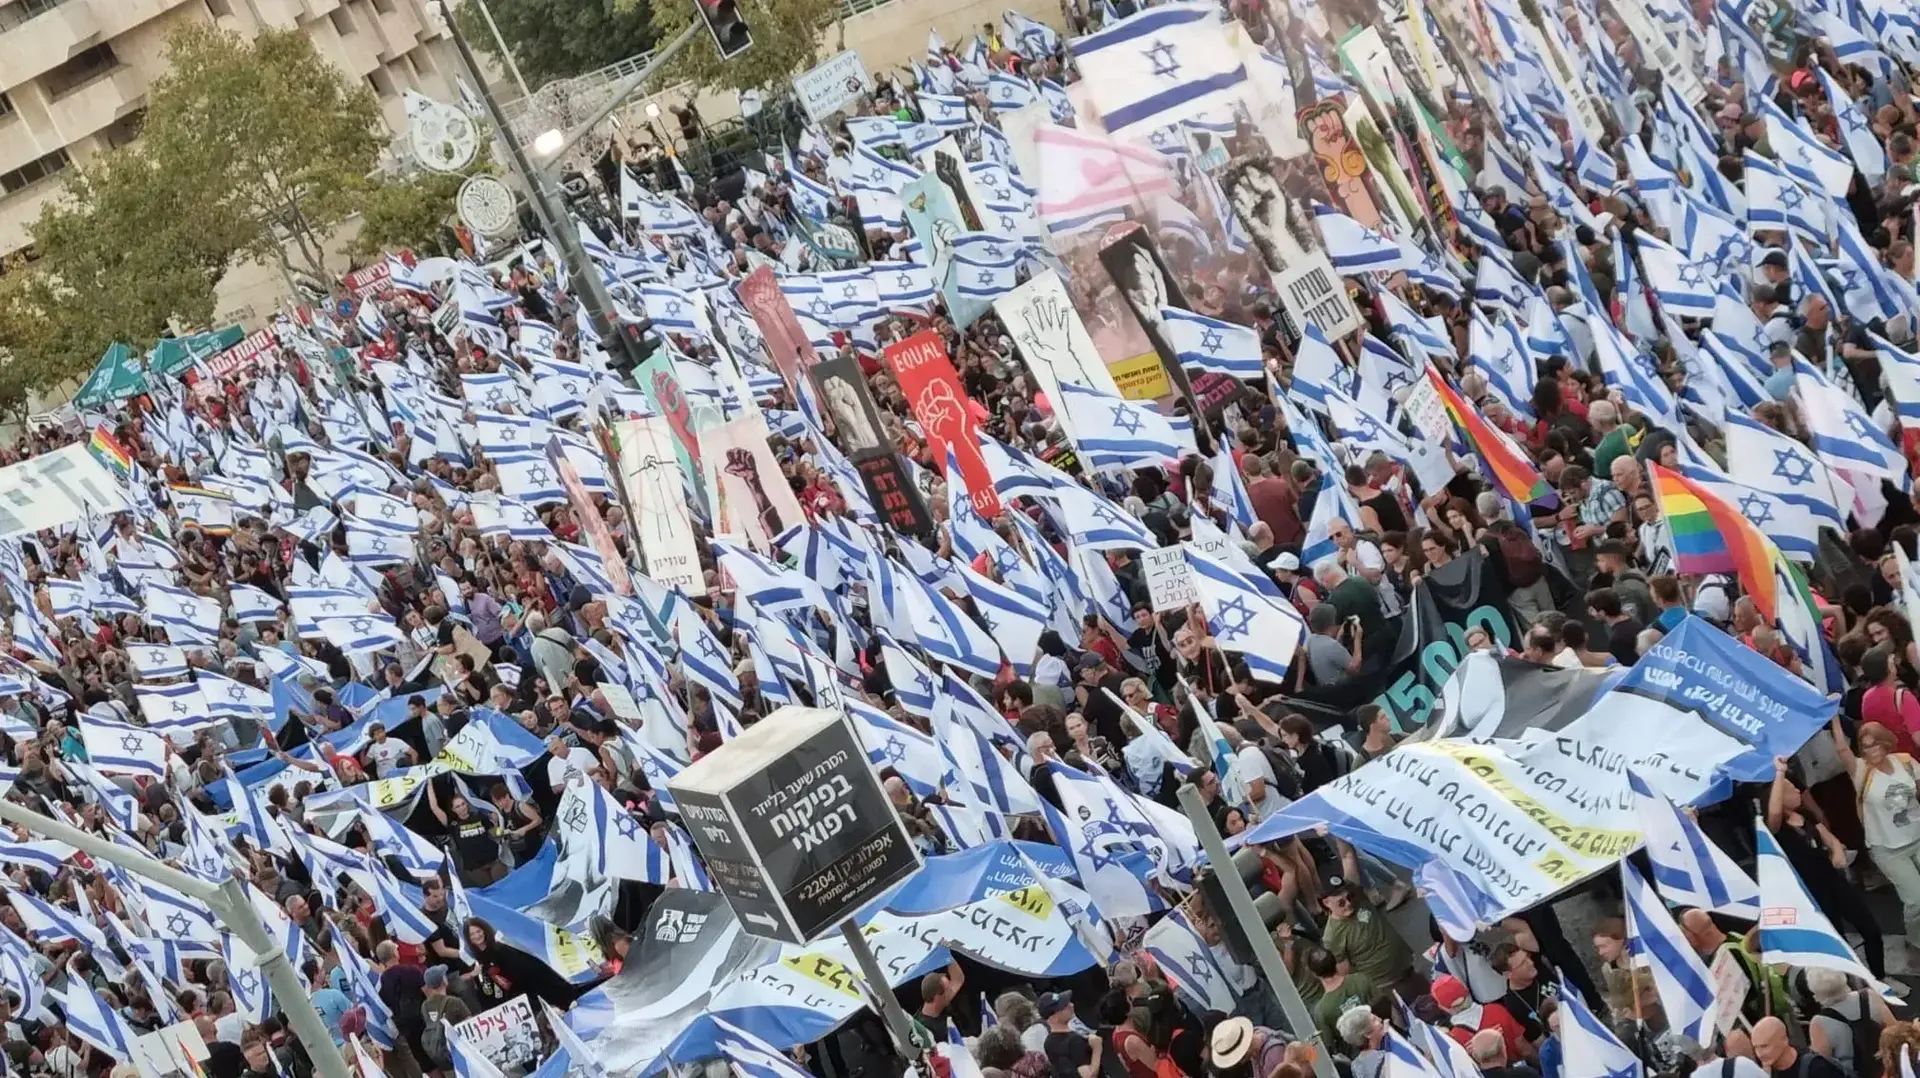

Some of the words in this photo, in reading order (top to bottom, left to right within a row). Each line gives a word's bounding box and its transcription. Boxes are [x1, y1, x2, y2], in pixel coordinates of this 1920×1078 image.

[893, 341, 942, 372] EQUAL
[971, 482, 999, 510] GHT
[1758, 695, 1788, 722] 2015
[815, 750, 848, 778] הסרת
[786, 771, 813, 794] שיער
[751, 791, 787, 816] בלייזר
[770, 775, 852, 837] בפיקוח
[792, 804, 857, 852] רפואי
